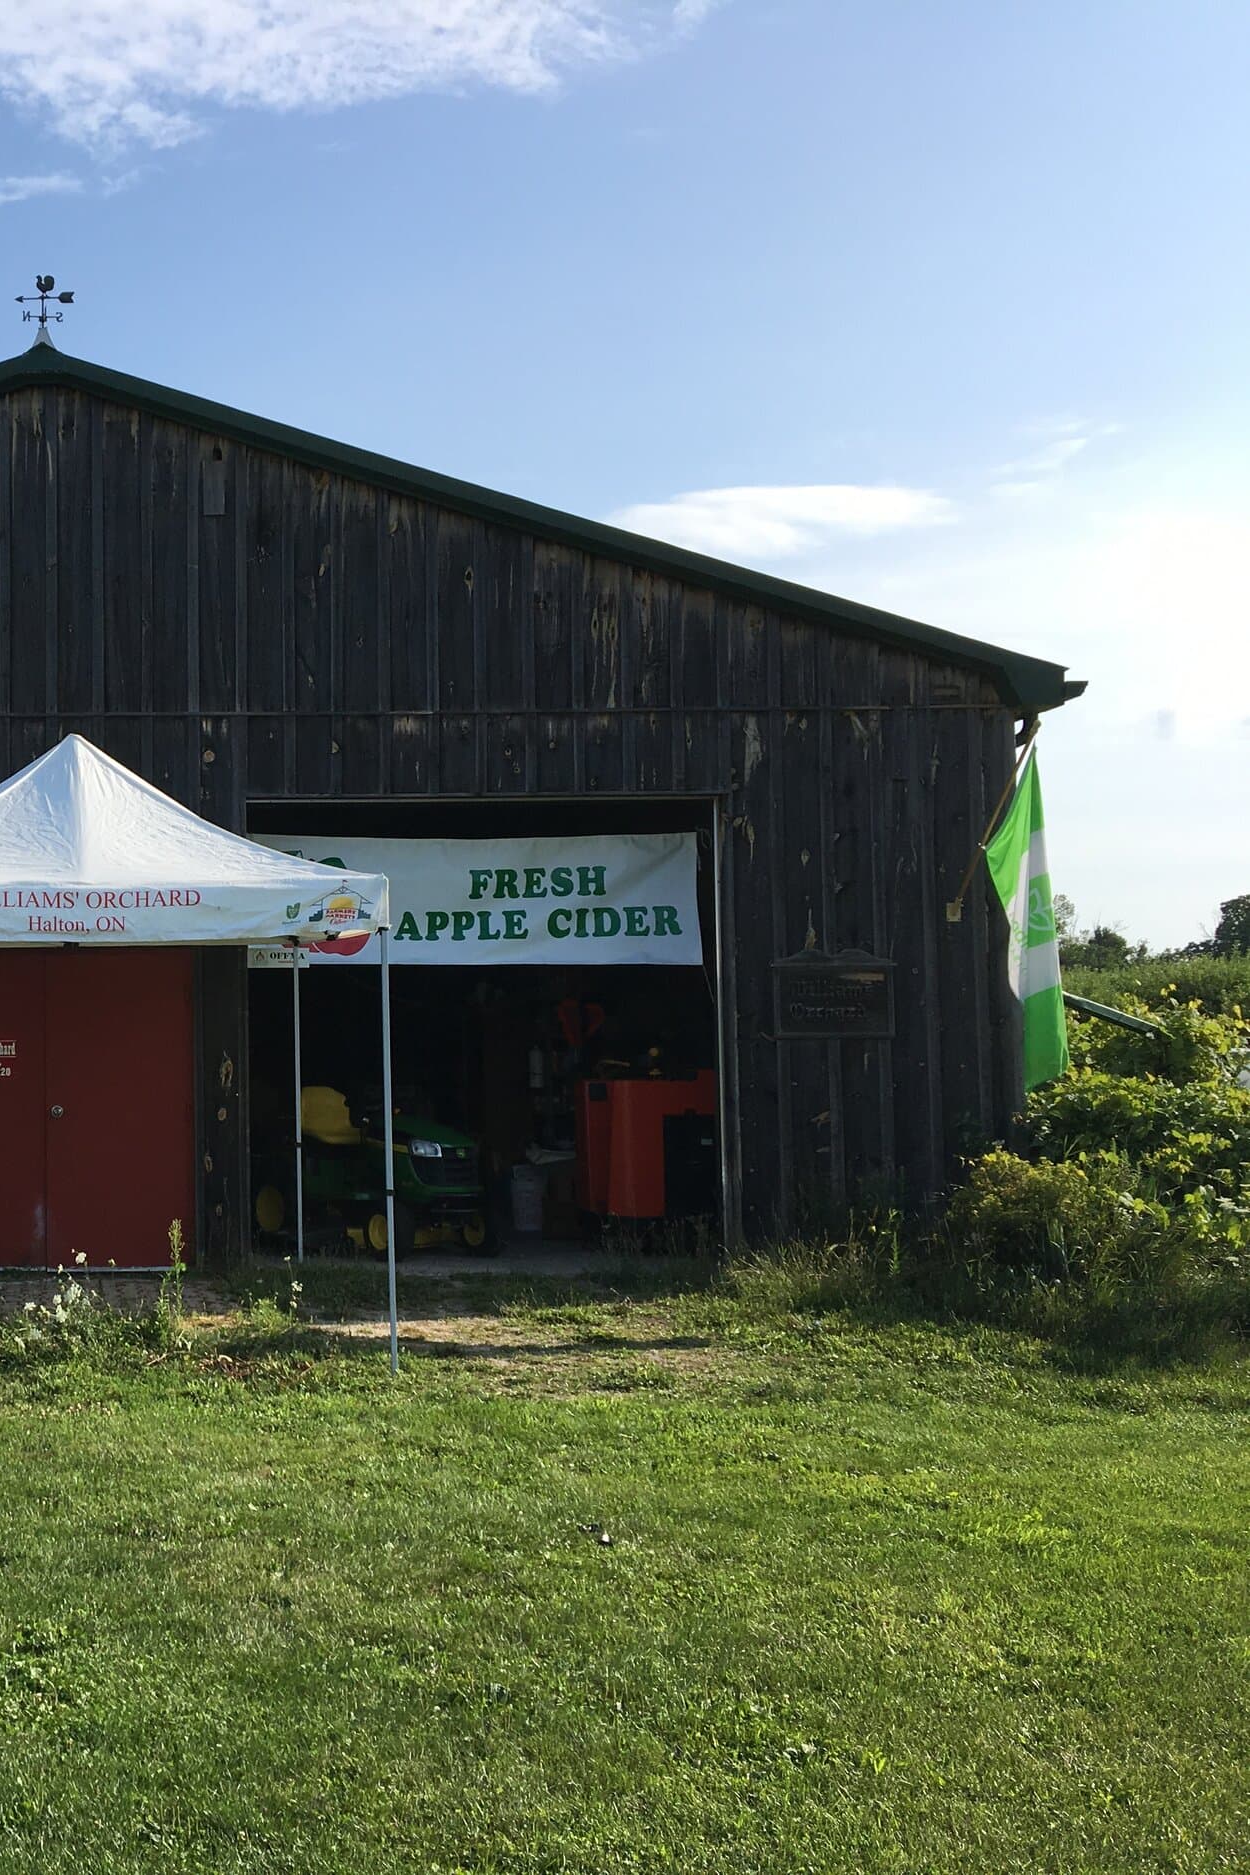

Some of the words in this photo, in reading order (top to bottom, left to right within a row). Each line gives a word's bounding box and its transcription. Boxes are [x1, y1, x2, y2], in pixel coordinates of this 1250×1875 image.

[468, 865, 607, 899] FRESH
[86, 889, 201, 909] ORCHARD
[28, 916, 90, 935] Halton,
[96, 916, 126, 932] ON
[393, 910, 529, 941] APPLE
[547, 905, 682, 940] CIDER
